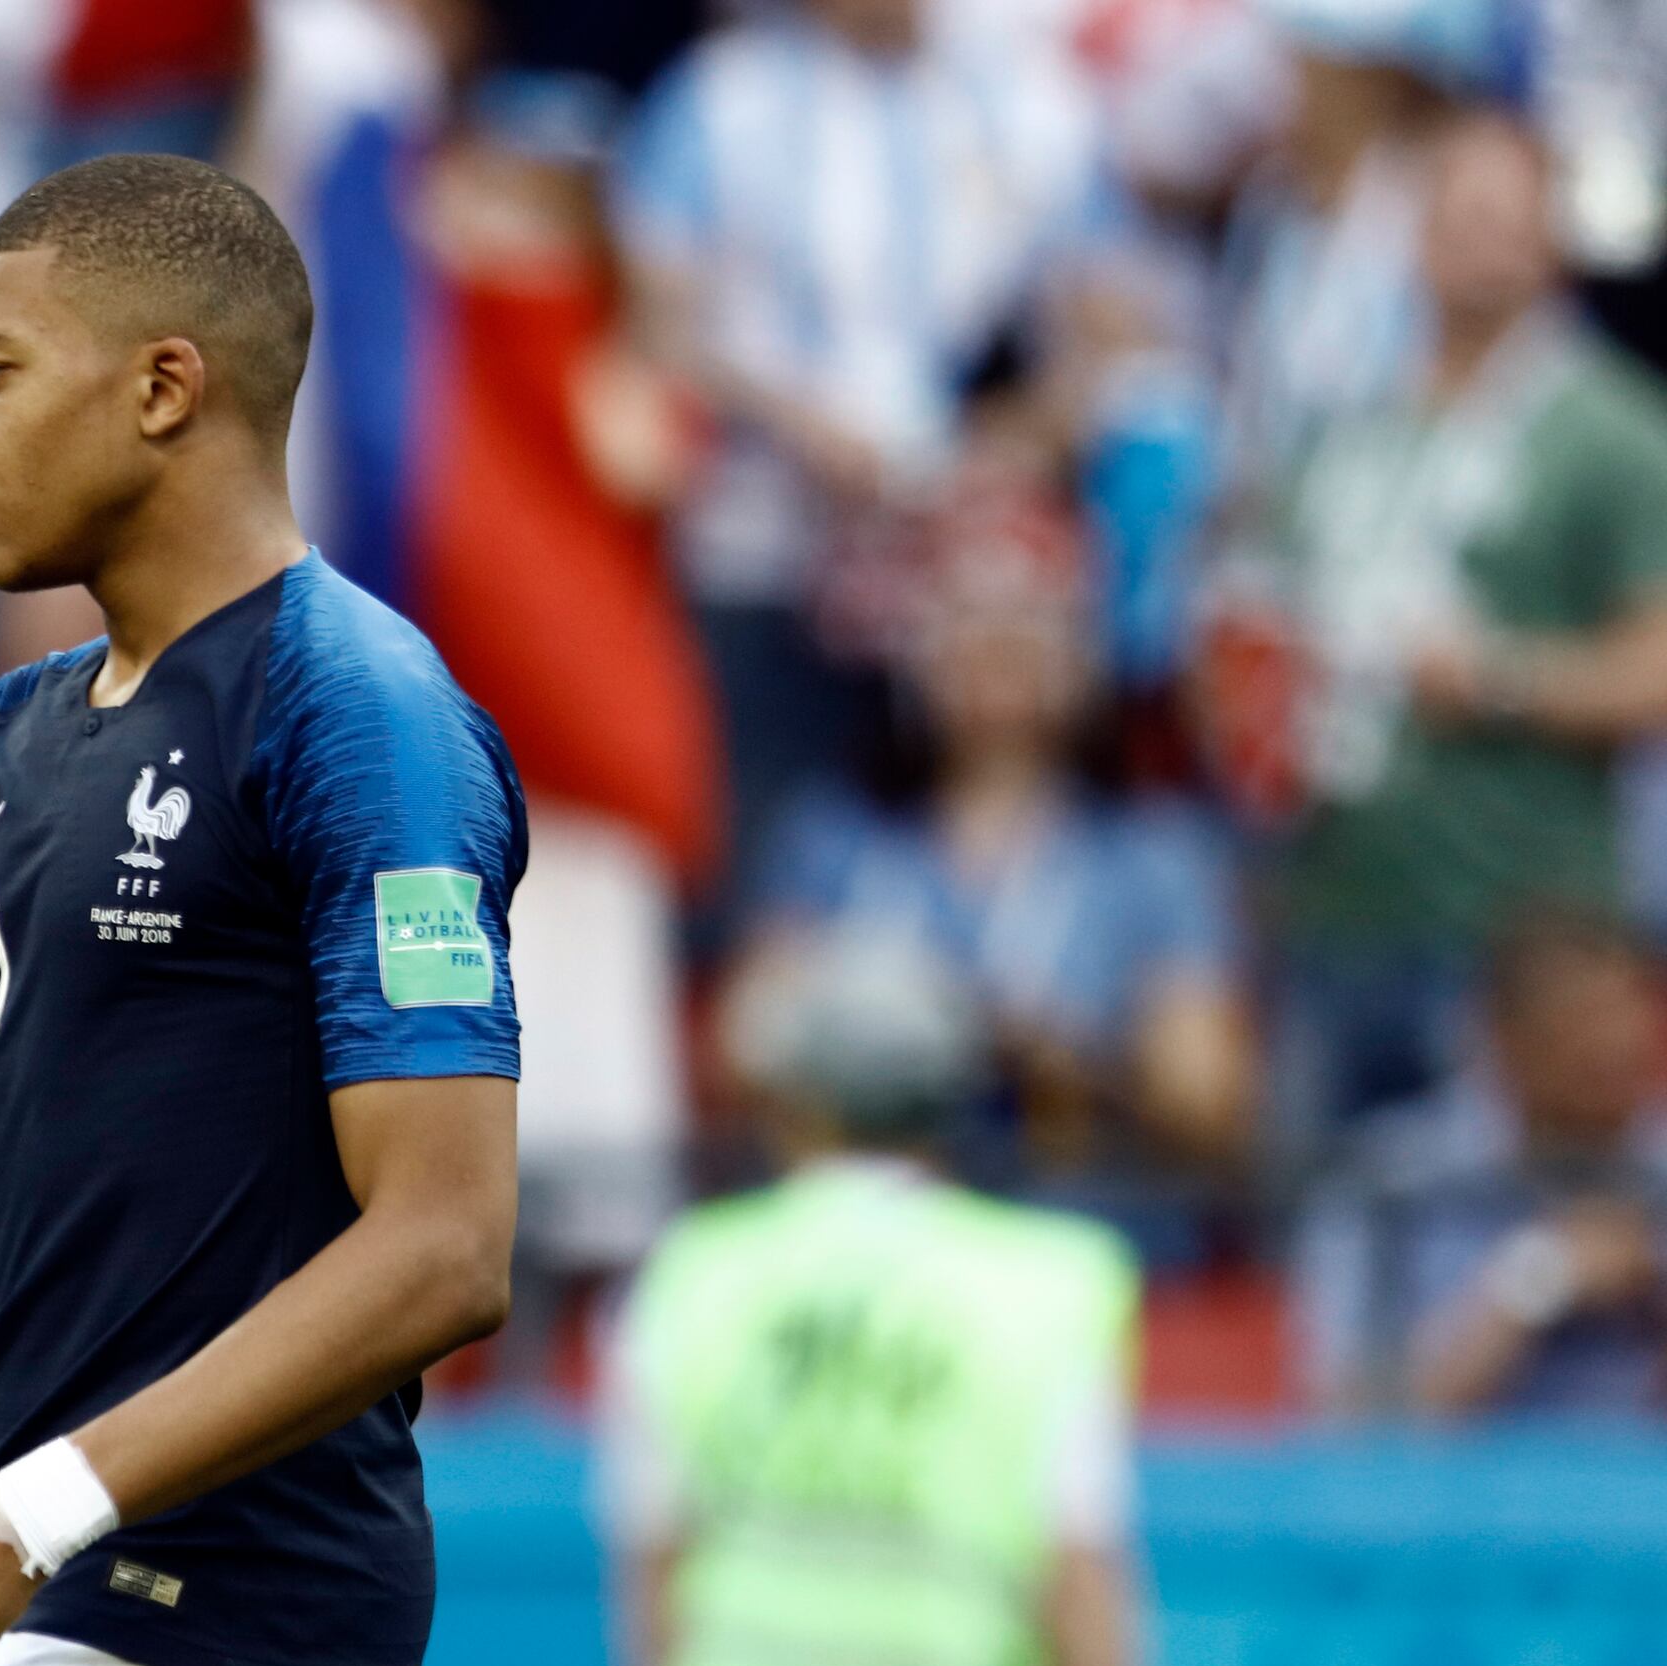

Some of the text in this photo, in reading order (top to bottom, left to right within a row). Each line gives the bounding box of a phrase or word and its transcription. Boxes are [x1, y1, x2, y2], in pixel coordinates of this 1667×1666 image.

[116, 878, 160, 898] FFF
[90, 907, 183, 928] FRANCE-ARGENTINE
[388, 910, 467, 926] LIVIN
[97, 925, 171, 943] 30 JUIN 2018
[451, 952, 484, 967] FIFA
